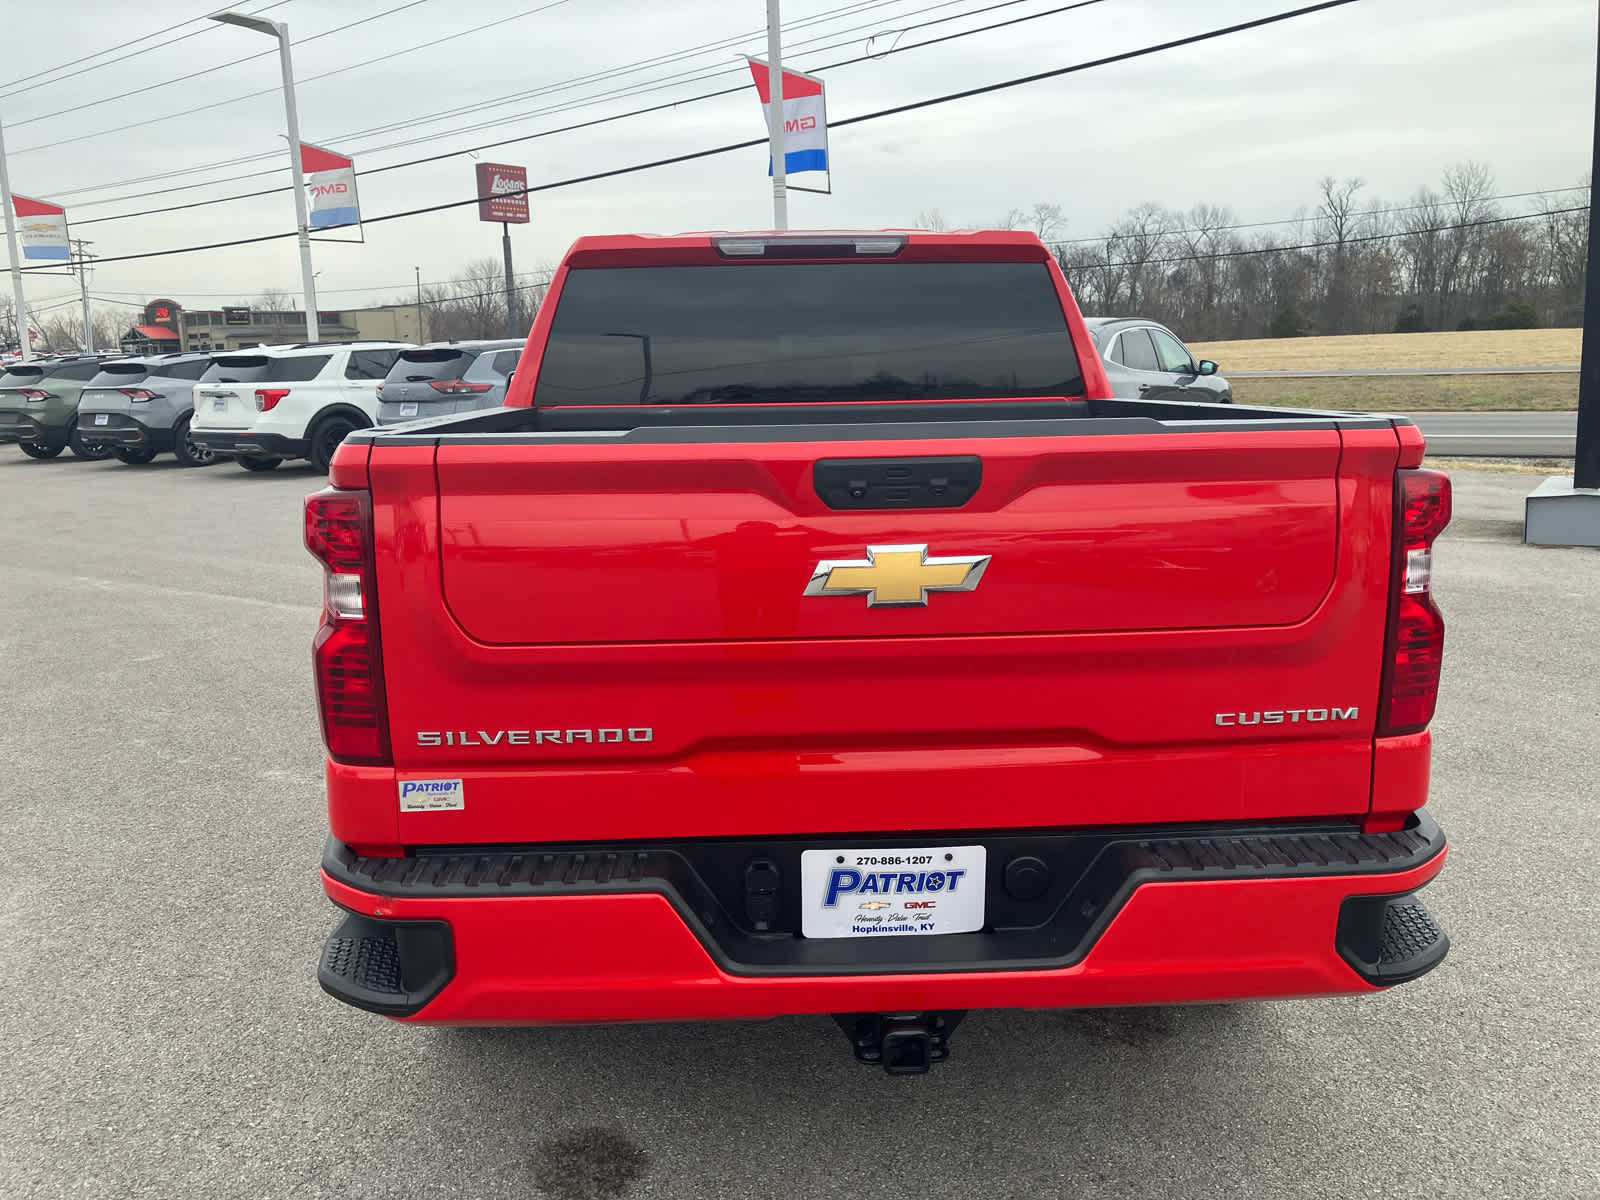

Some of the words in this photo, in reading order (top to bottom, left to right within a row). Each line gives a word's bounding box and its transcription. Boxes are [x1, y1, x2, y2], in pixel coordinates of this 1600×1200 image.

[1215, 706, 1360, 726] CUSTOM
[416, 727, 653, 747] SILVERADO
[402, 781, 460, 798] PATRIOT
[856, 855, 933, 866] 270-886-1207
[822, 868, 967, 908] PATRIOT
[904, 900, 937, 909] GMC
[852, 923, 917, 934] Hopkinsville,
[920, 922, 935, 931] KY
